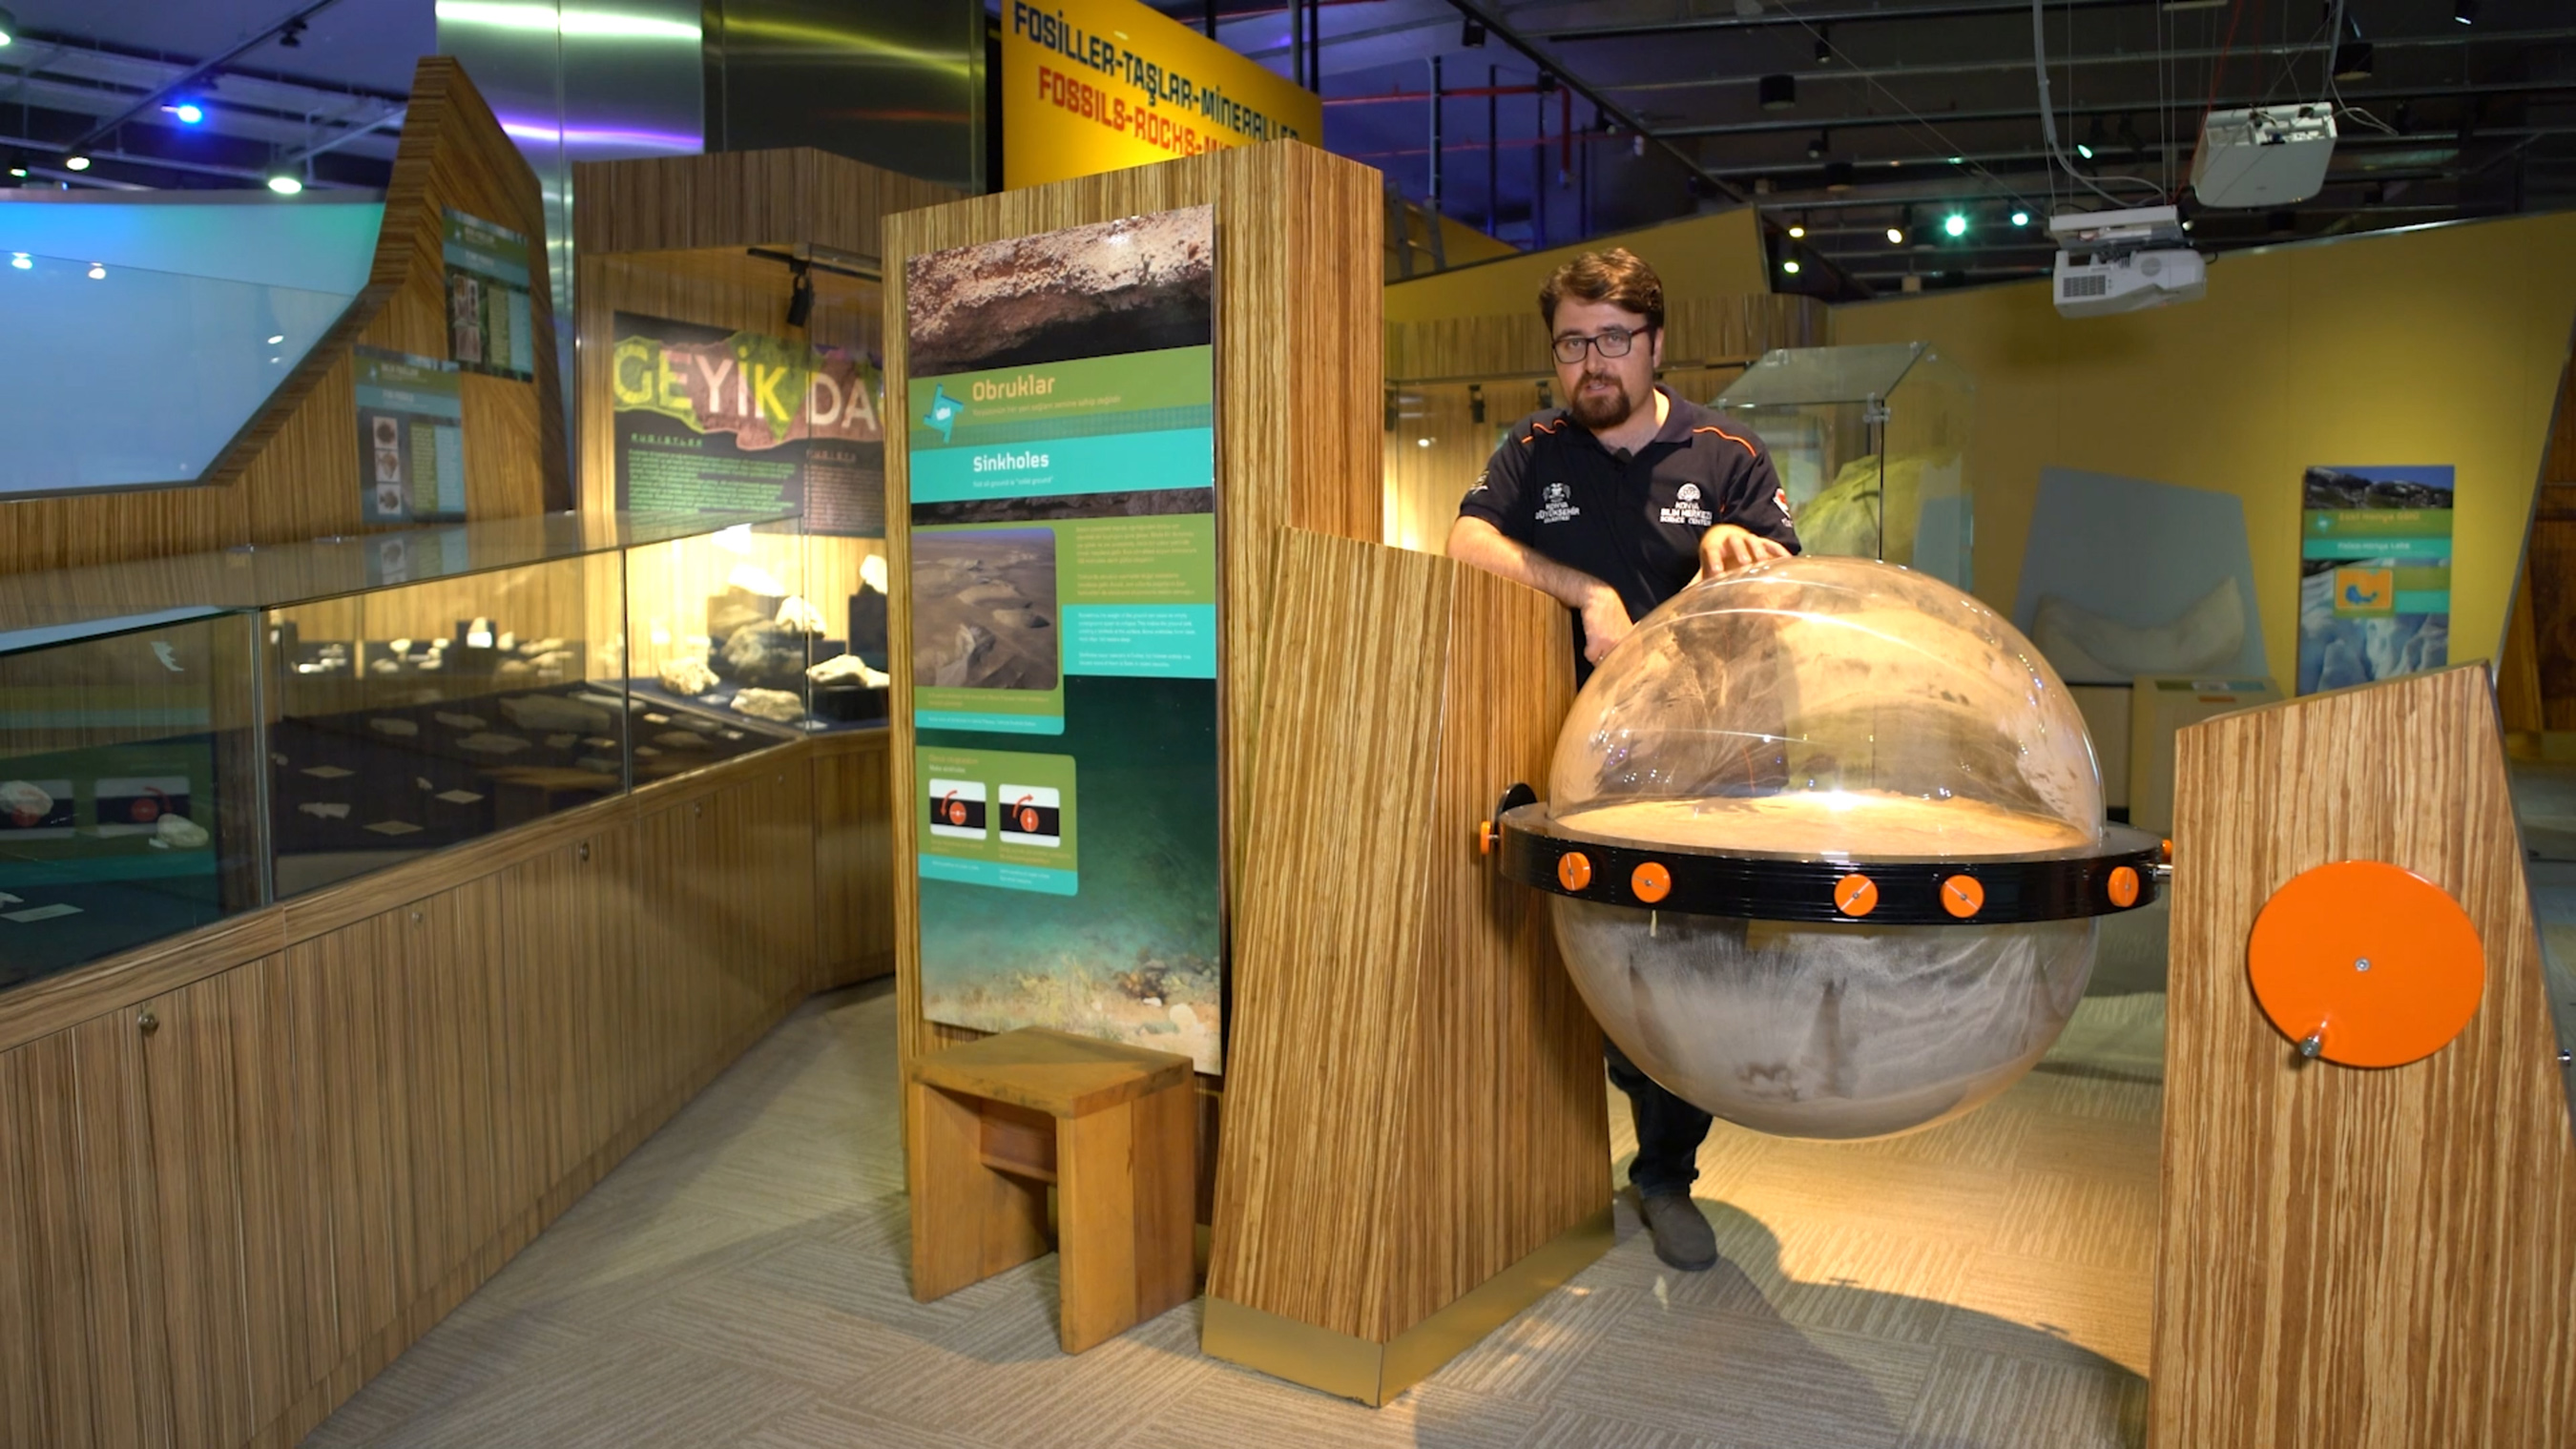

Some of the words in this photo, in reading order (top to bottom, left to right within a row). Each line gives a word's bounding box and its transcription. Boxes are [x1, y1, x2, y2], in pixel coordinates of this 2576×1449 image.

[1039, 65, 1235, 156] FOSSILS-ROCKS-M
[613, 343, 790, 422] GEYİK
[806, 370, 883, 431] DA
[972, 374, 1055, 402] Obruklar
[973, 450, 1049, 472] Sinkholes
